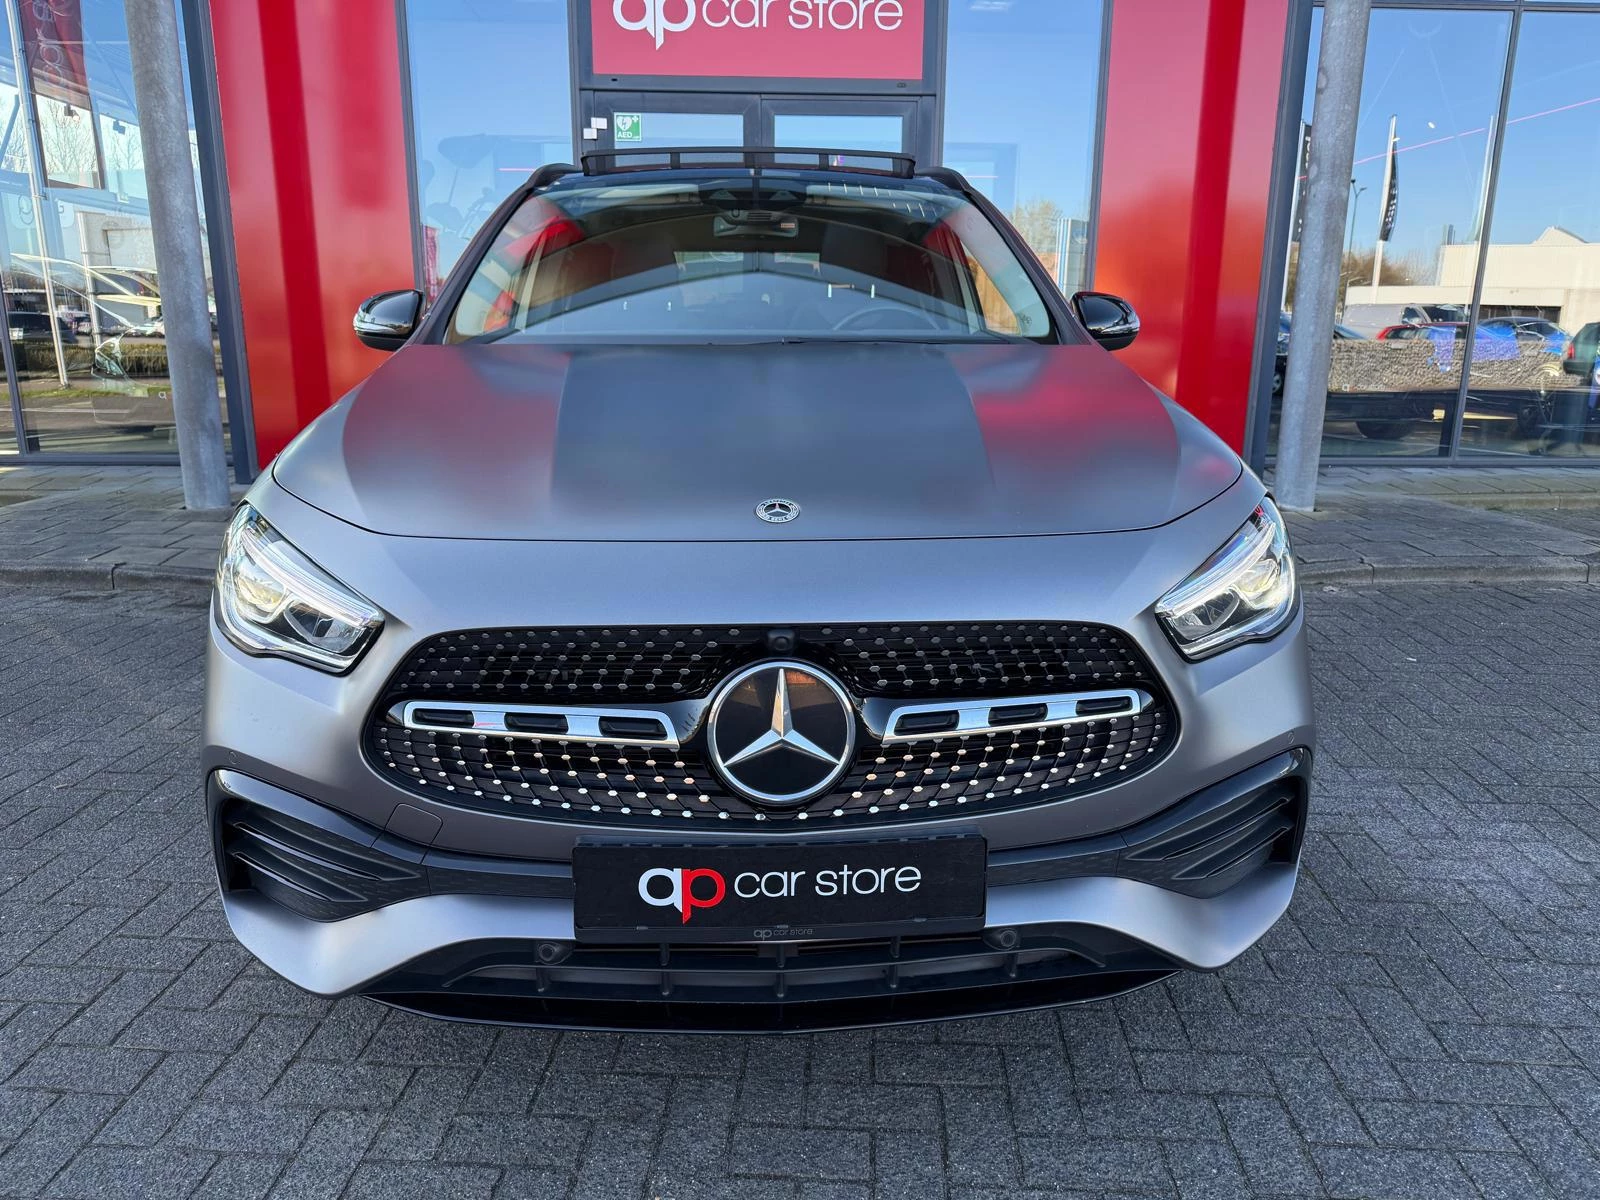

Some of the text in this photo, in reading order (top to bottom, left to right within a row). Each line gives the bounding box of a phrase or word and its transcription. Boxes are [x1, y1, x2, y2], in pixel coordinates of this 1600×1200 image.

[702, 0, 777, 28] car
[788, 0, 903, 31] store
[617, 131, 633, 139] AED
[637, 864, 922, 924] ap car store
